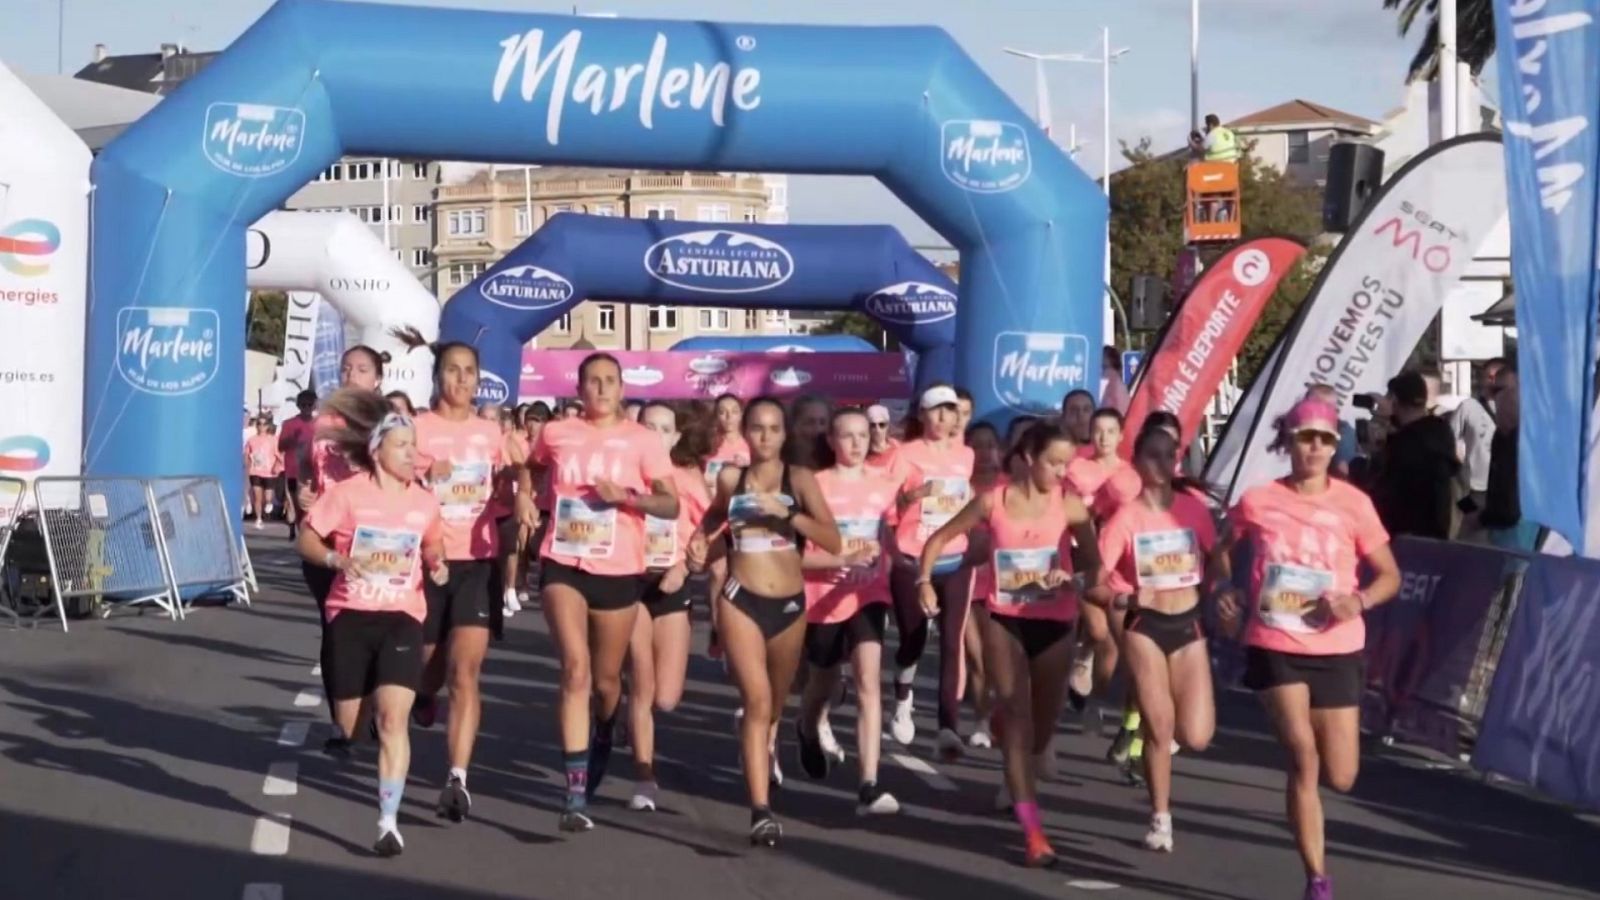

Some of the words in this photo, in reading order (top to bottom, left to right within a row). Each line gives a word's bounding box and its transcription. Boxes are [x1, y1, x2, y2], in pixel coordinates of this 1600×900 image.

[492, 28, 761, 146] Marlene
[211, 119, 296, 155] Marlene
[947, 136, 1024, 172] Marlene
[1400, 200, 1459, 240] SEAT
[656, 247, 782, 279] ASTURIANA
[329, 278, 391, 292] OYSHO
[486, 280, 566, 299] ASTURIANA
[873, 298, 955, 313] ASTURIANA
[123, 327, 213, 371] Marlene
[1160, 378, 1191, 416] UÑA
[1188, 289, 1241, 369] DEPORTE
[1000, 350, 1082, 394] Marlene
[1401, 572, 1442, 602] EAT
